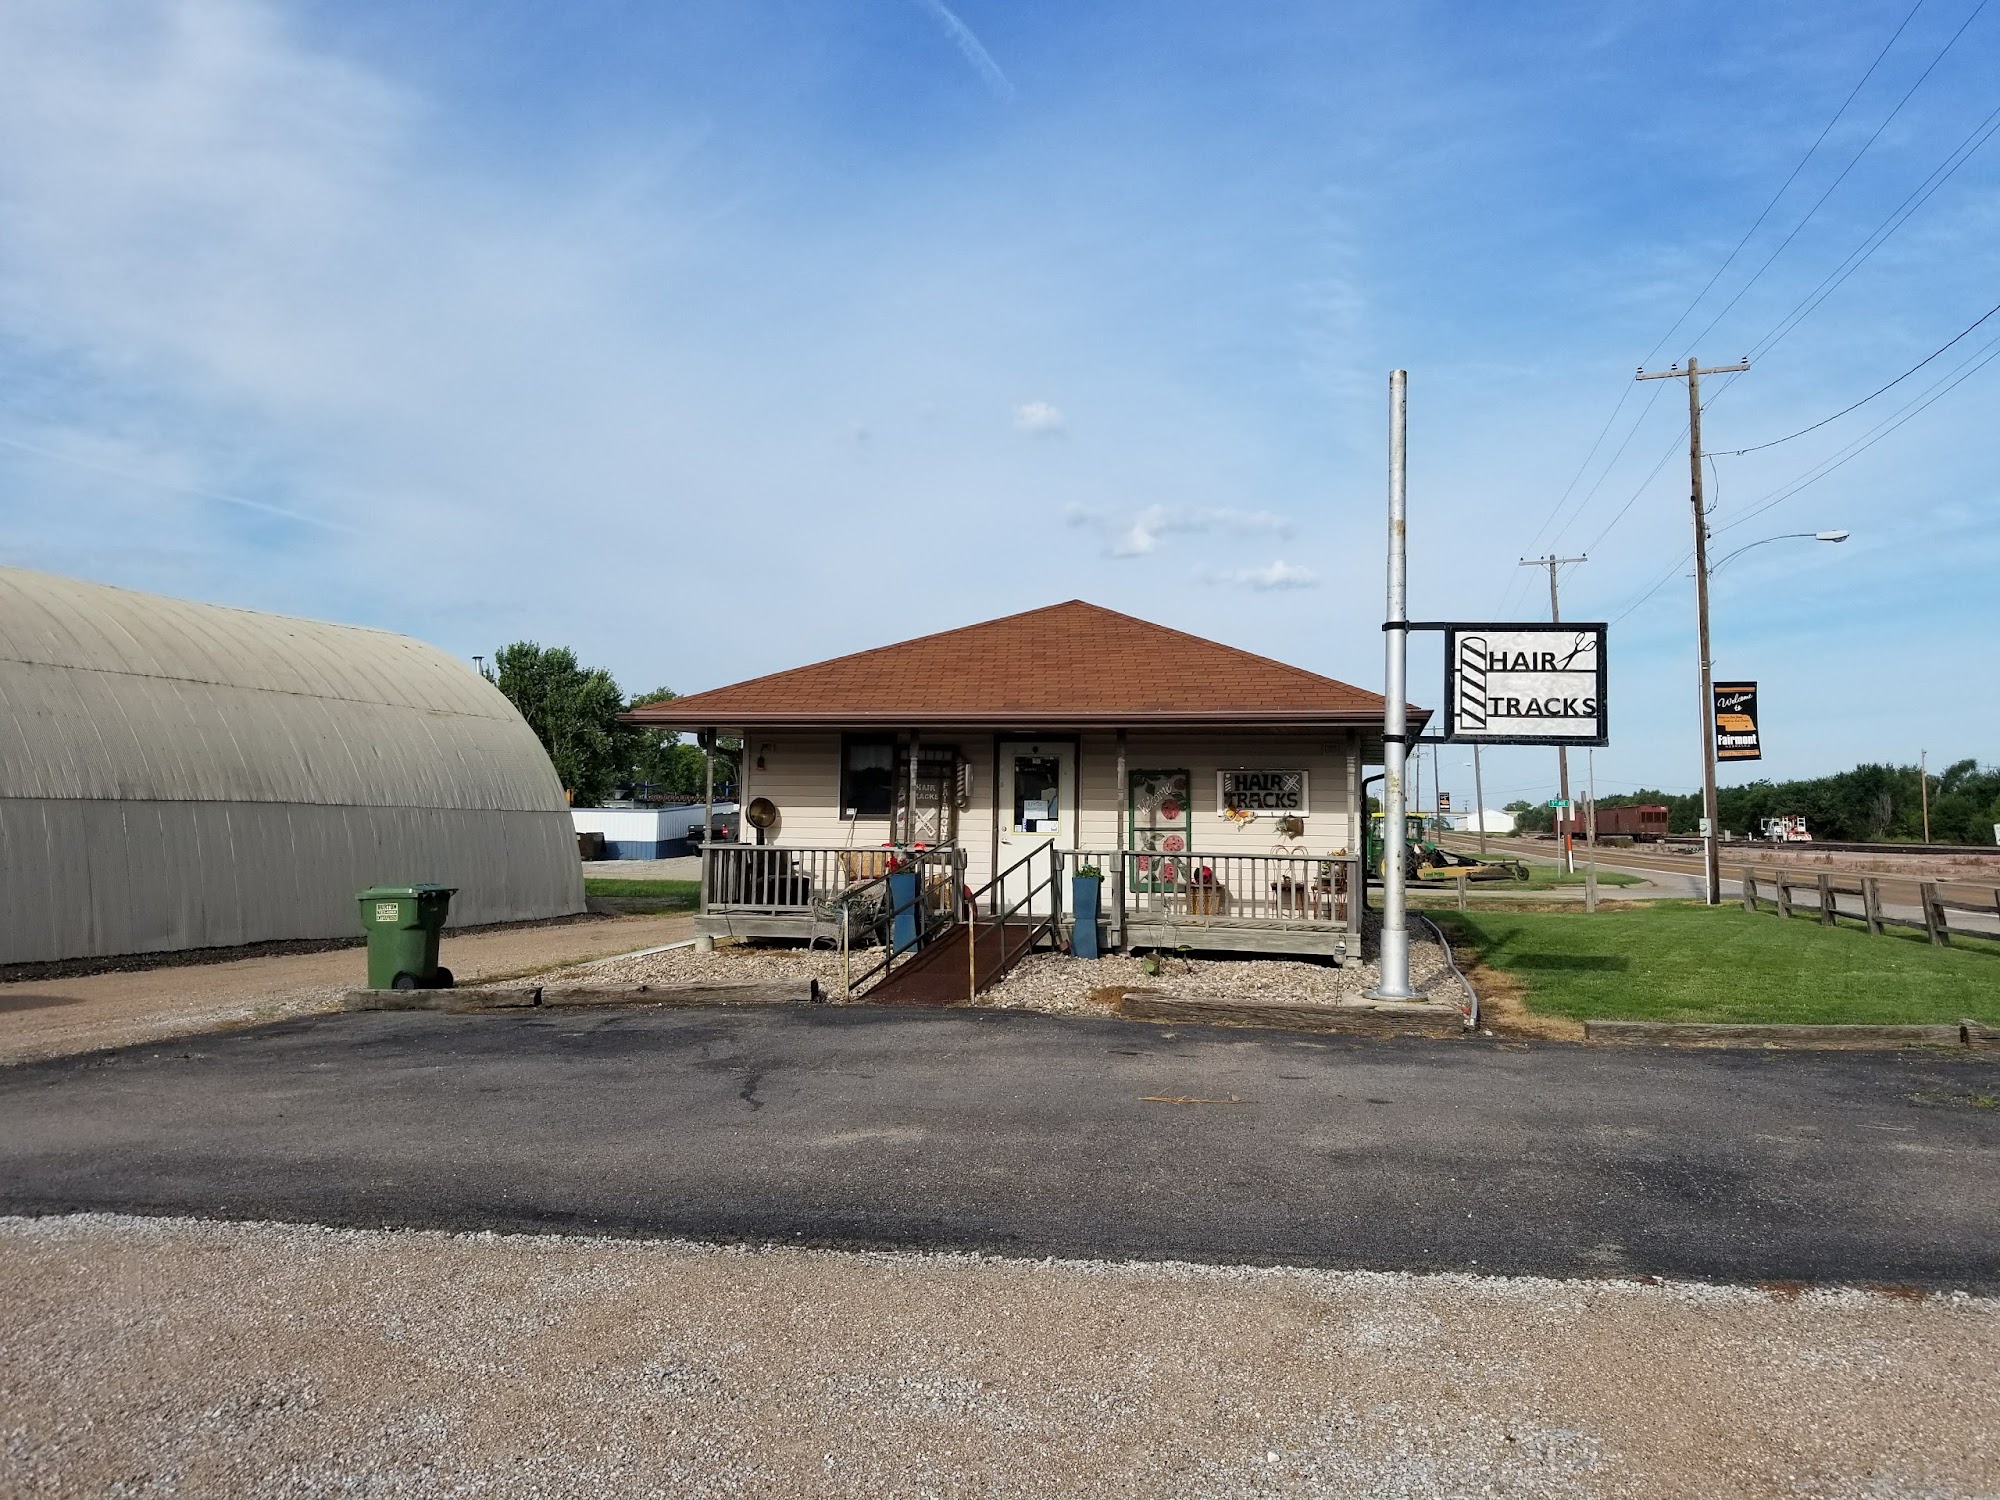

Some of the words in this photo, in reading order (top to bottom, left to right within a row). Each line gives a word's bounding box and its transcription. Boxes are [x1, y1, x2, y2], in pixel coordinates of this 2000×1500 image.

[1489, 652, 1557, 671] HAIR
[1488, 697, 1596, 716] TRACKS
[1717, 693, 1752, 707] Welcome
[1718, 734, 1757, 745] Fairmont
[1234, 774, 1285, 791] HAIR
[1136, 782, 1172, 816] Welcome
[1224, 792, 1298, 809] TRACKS
